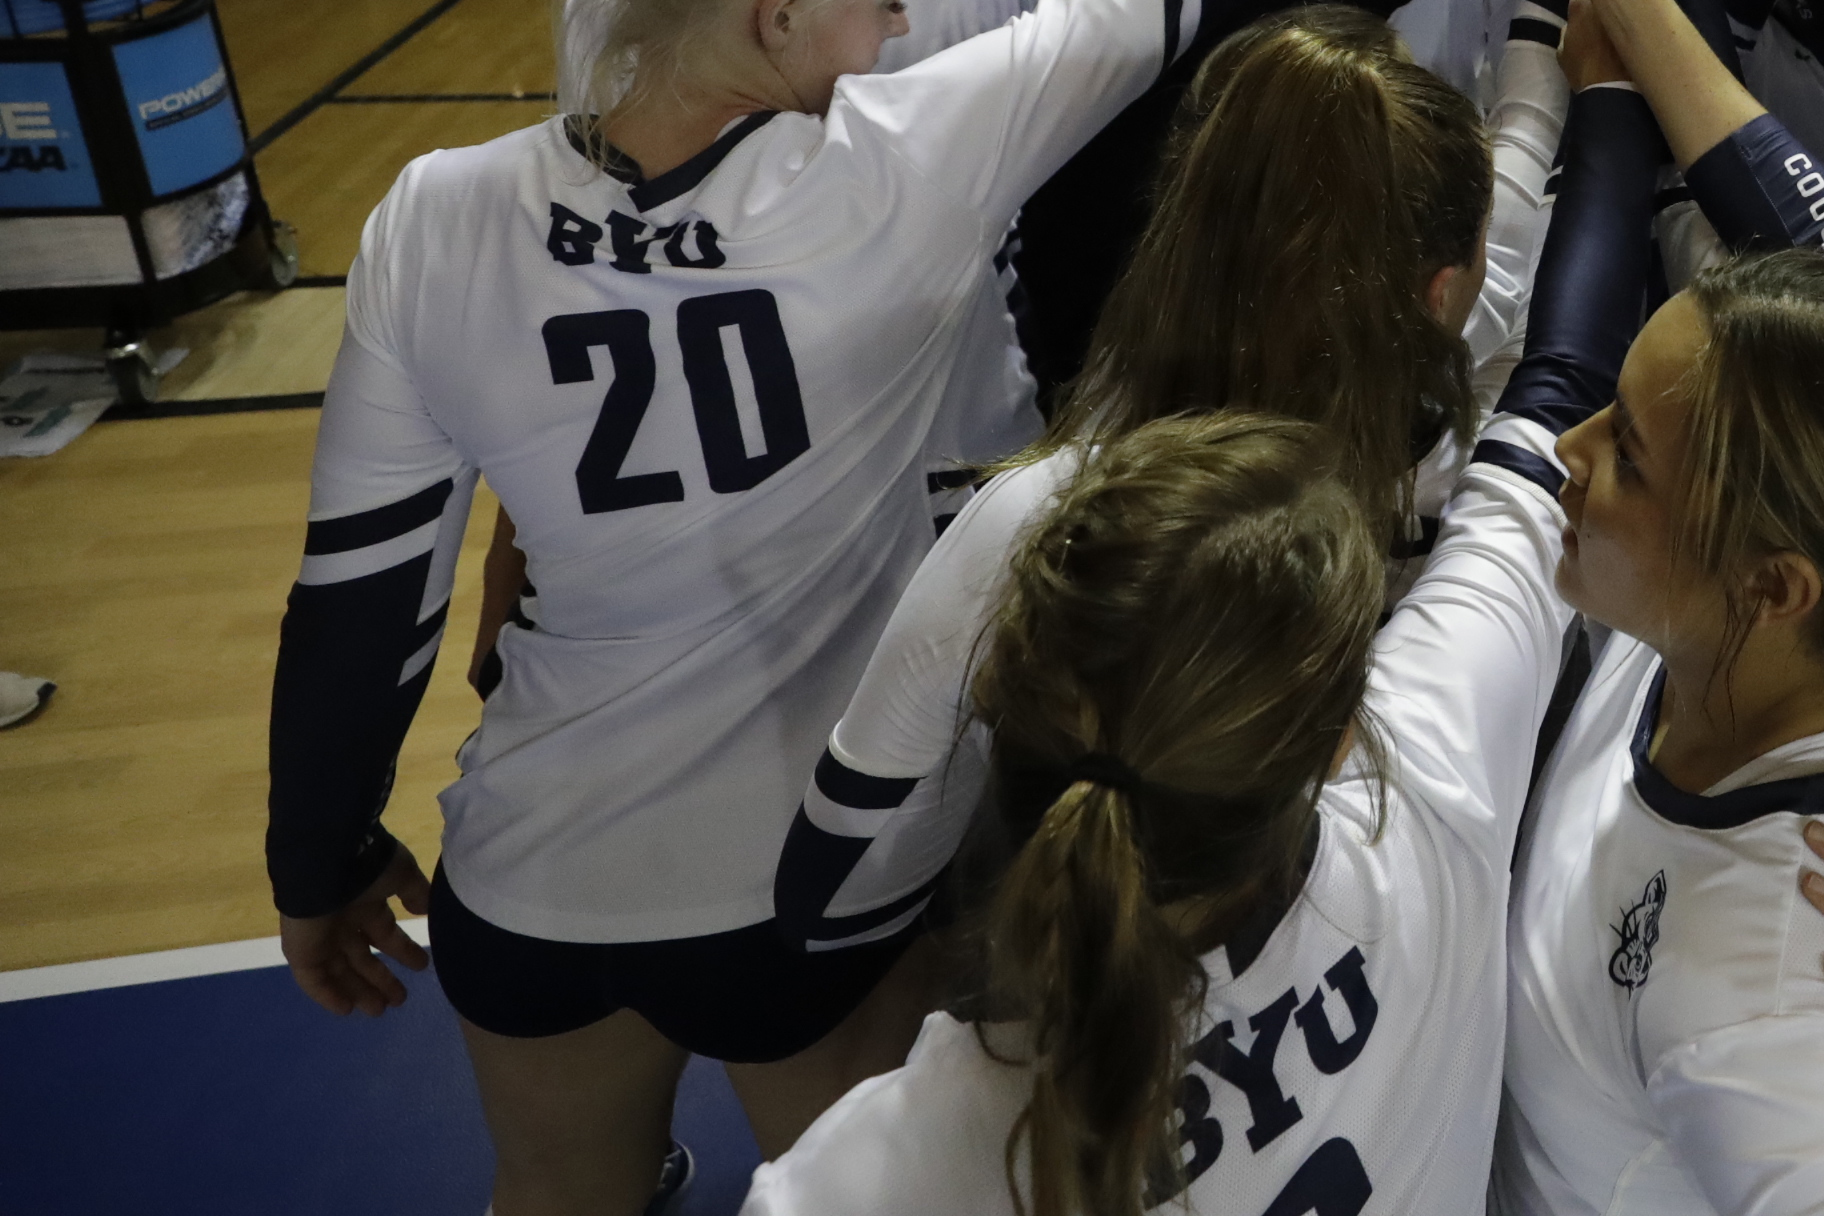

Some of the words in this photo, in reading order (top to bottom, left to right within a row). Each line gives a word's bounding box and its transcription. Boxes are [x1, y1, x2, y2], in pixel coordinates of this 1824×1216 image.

[547, 202, 726, 274] BYU
[542, 288, 811, 515] 20
[1142, 945, 1378, 1211] BYU
